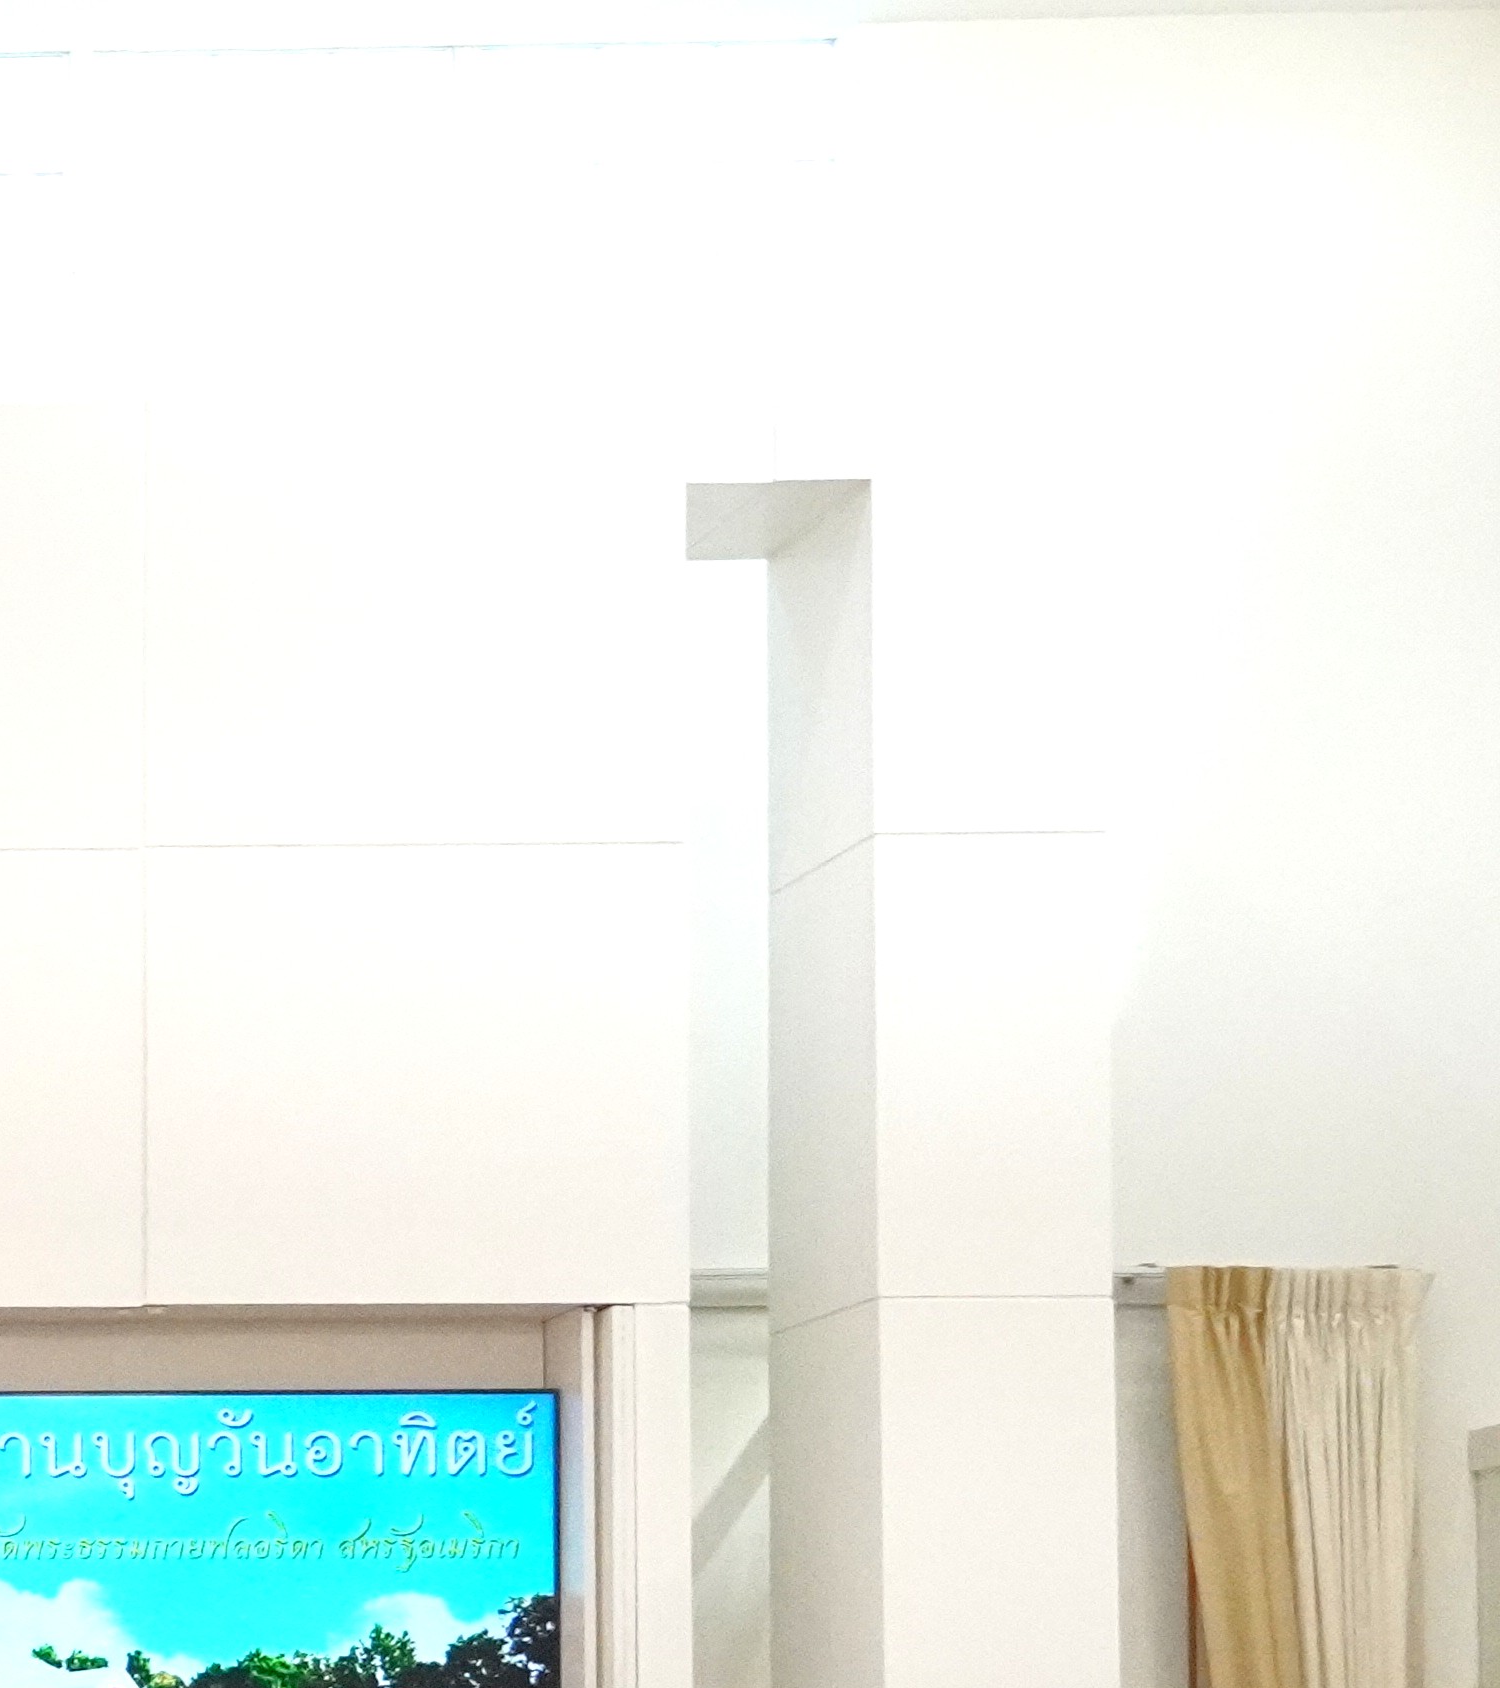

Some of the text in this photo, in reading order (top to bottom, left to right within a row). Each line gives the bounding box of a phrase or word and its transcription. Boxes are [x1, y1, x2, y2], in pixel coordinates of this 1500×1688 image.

[339, 1511, 520, 1573] สหรัฐอเมริกา
